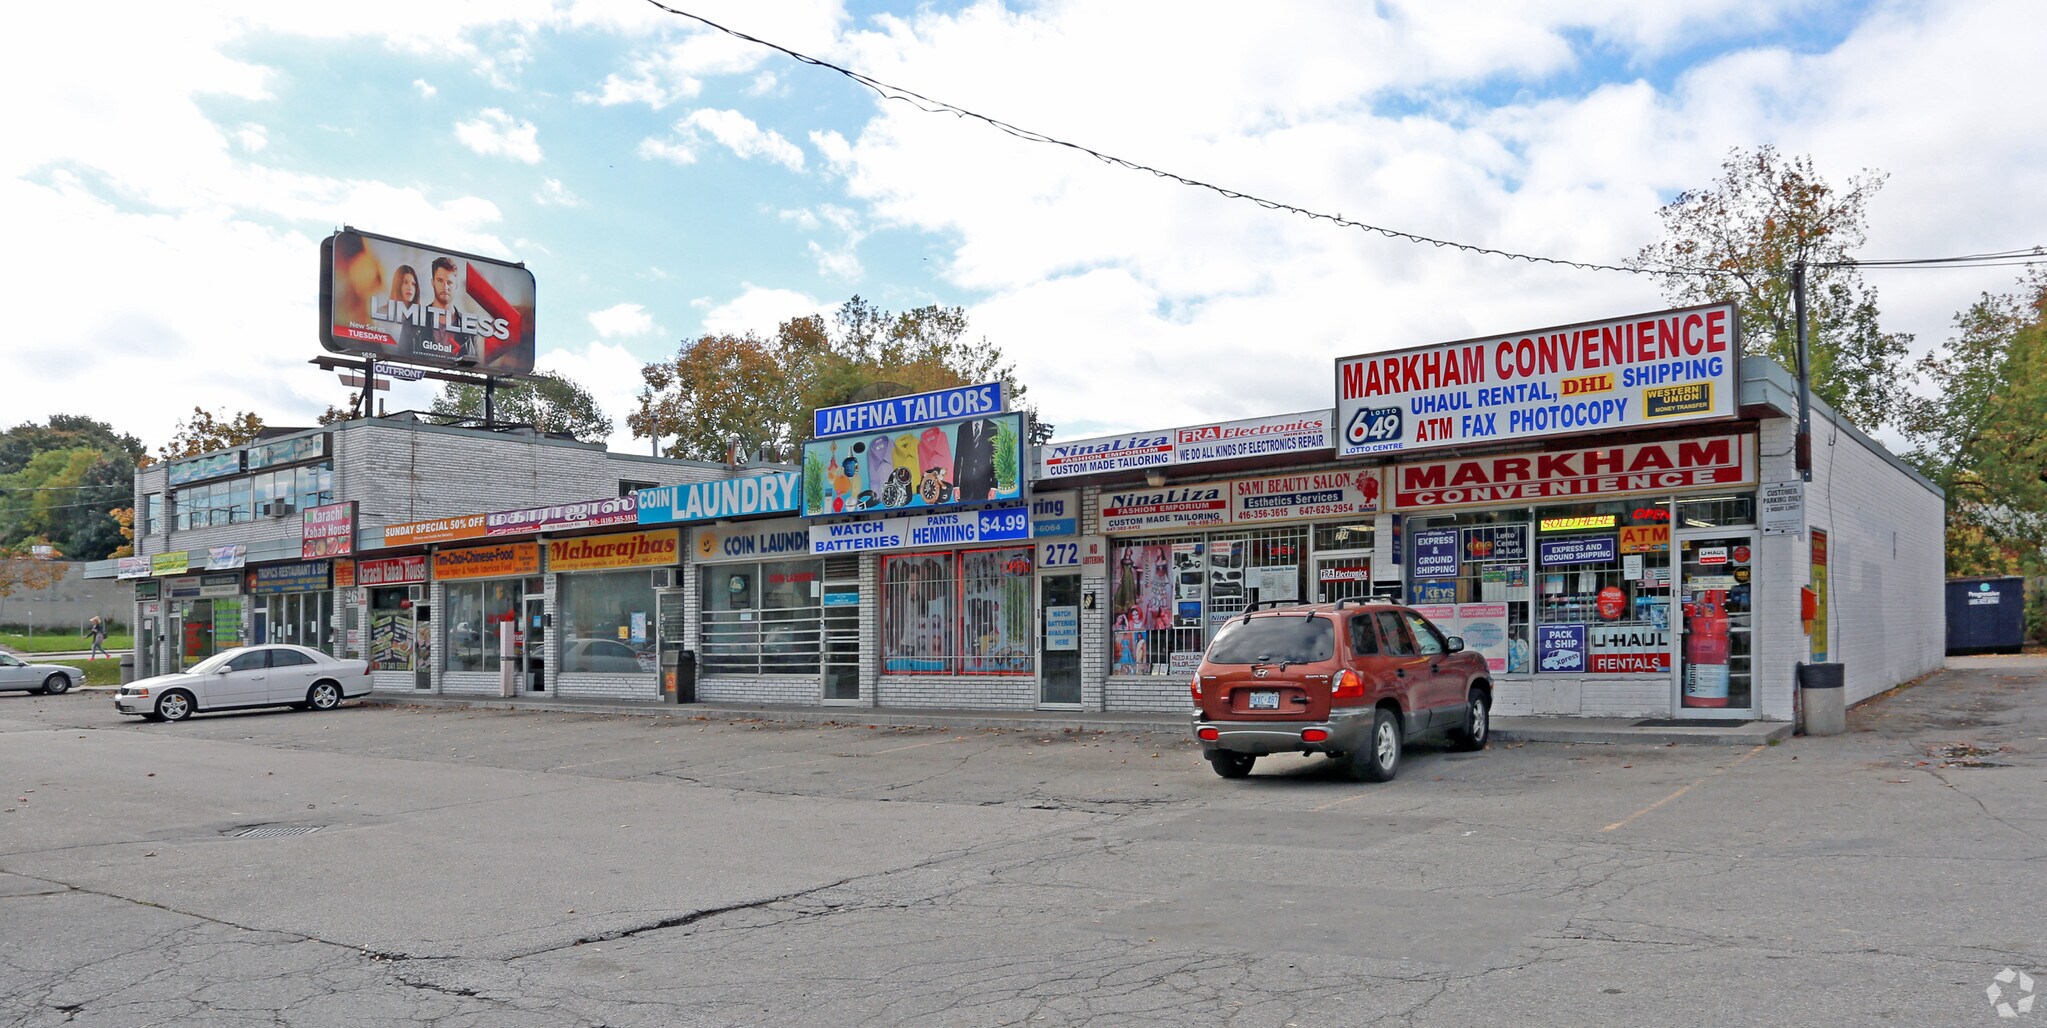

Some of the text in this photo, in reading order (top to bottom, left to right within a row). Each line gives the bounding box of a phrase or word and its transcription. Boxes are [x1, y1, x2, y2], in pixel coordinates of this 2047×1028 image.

[371, 296, 510, 341] LIMITLESS
[348, 329, 388, 342] TUESDAYS
[366, 323, 386, 333] Series
[422, 340, 452, 353] Global
[1343, 310, 1726, 400] MARKHAM CONVENIENCE
[375, 364, 422, 379] OUTFRONT
[1411, 356, 1723, 415] UHAUL RENTAL, DHL SHIPPING
[1648, 385, 1699, 398] WESTERN
[1663, 392, 1700, 404] UNION
[823, 387, 993, 434] JAFFNA TAILORS
[1371, 408, 1397, 416] LOTTO
[1655, 402, 1707, 413] MONEY TRANSFER
[1349, 411, 1399, 444] 649
[1416, 397, 1628, 443] ATM FAX PHOTOCOPY
[1180, 419, 1323, 443] FRA Electronics
[1052, 436, 1168, 458] NinaLiza
[1180, 434, 1324, 461] WE DO ALL KINDS OF ELECTRONICS REPAIR
[1345, 442, 1403, 454] LOTTO CENTRE
[1061, 447, 1159, 464] FASHION EMPORIUM
[1050, 453, 1168, 476] CUSTOM MADE TAILORING
[1405, 439, 1729, 491] MARKHAM
[1238, 481, 1263, 496] SAMI
[1268, 476, 1308, 492] BEAUTY
[1416, 470, 1716, 506] CONVENIENCE
[1767, 488, 1797, 497] CUSTOMER
[639, 472, 799, 520] COIN LAUNDRY
[1110, 488, 1219, 509] NinaLiza
[1248, 492, 1339, 509] Esthetics Services
[1763, 496, 1787, 504] PARKING
[312, 506, 343, 524] Karachi
[1118, 502, 1210, 515] FASHION EMPORIUM
[1238, 503, 1353, 520] 416-356-3615 647-629-2954
[1632, 508, 1670, 521] OPEN
[385, 516, 485, 537] SUNDAY SPECIAL 50% OFF
[829, 514, 1026, 537] WATCH PANTS $4.99
[1109, 512, 1220, 527] CUSTOM MADE TAILORING
[304, 524, 350, 539] Kabab House
[815, 524, 975, 552] BATTERIES HEMMING
[1496, 532, 1515, 540] Lotto
[1623, 528, 1668, 543] ATM
[552, 535, 676, 561] Maharajhas
[724, 530, 810, 556] COIN LAUNDR
[1418, 536, 1454, 546] EXPRESS
[434, 547, 514, 566] Tim-Choi-Chinese-Food
[1046, 543, 1078, 565] 272
[1090, 544, 1098, 555] NO
[1433, 546, 1439, 555] &
[1544, 550, 1611, 562] GROUND SHIPPING
[1552, 545, 1584, 554] EXPRESS
[501, 562, 512, 571] Food
[1083, 556, 1105, 565] LOITERING
[1418, 556, 1453, 565] GROUND
[258, 567, 278, 579] TROPICS
[279, 564, 311, 578] RESTAURANT
[311, 563, 317, 575] &
[360, 563, 382, 583] Karachi
[384, 561, 402, 582] Kabab
[404, 560, 425, 581] House
[1321, 568, 1368, 579] FRA Electronics
[1416, 565, 1455, 575] SHIPPING
[1426, 587, 1455, 598] KEYS
[1549, 630, 1572, 639] PACK
[1592, 633, 1668, 648] U-HAUL
[1545, 640, 1577, 649] & SHIP
[1556, 653, 1579, 667] Xpress
[1597, 658, 1661, 670] RENTALS
[1688, 664, 1696, 693] vitamin
